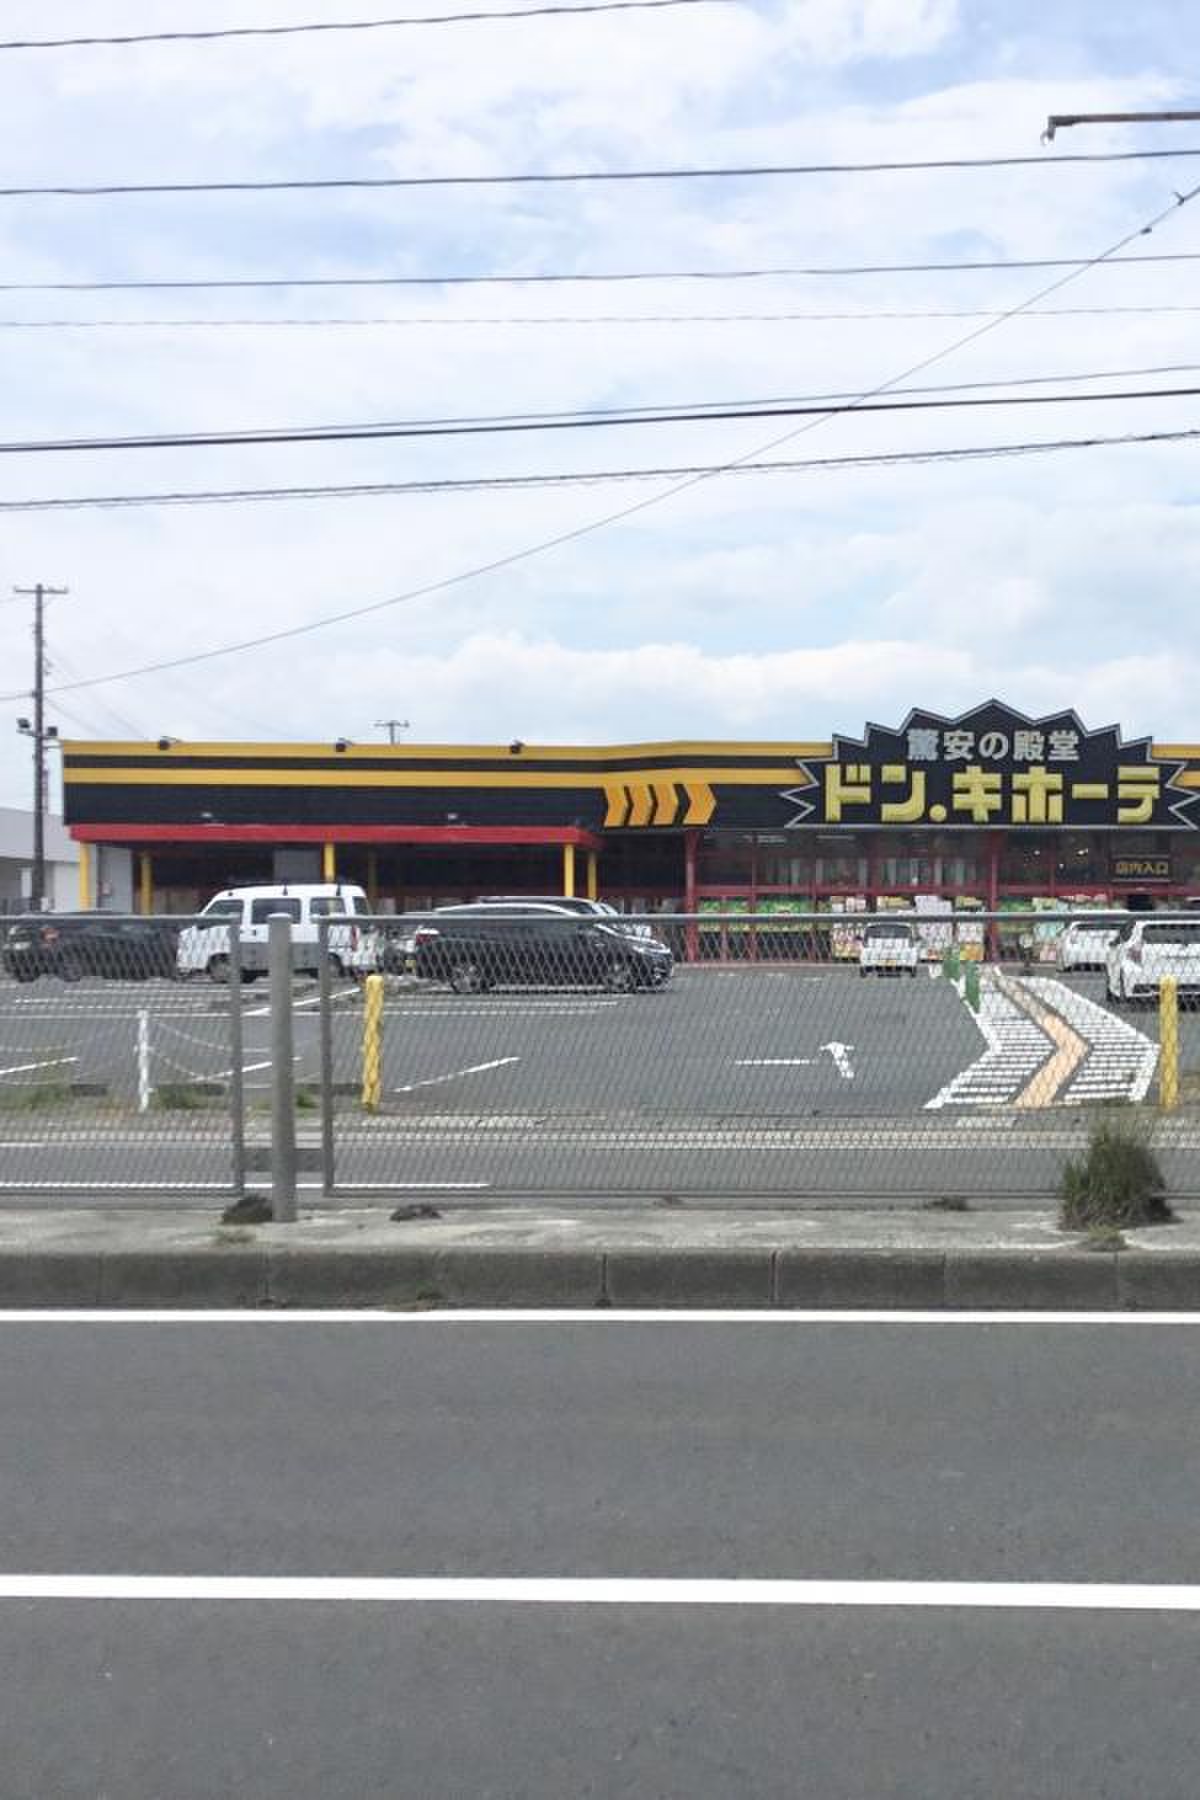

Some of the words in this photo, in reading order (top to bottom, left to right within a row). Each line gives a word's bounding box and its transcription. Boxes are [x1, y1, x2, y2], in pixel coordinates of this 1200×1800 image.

[907, 729, 1079, 761] 驚安の殿堂
